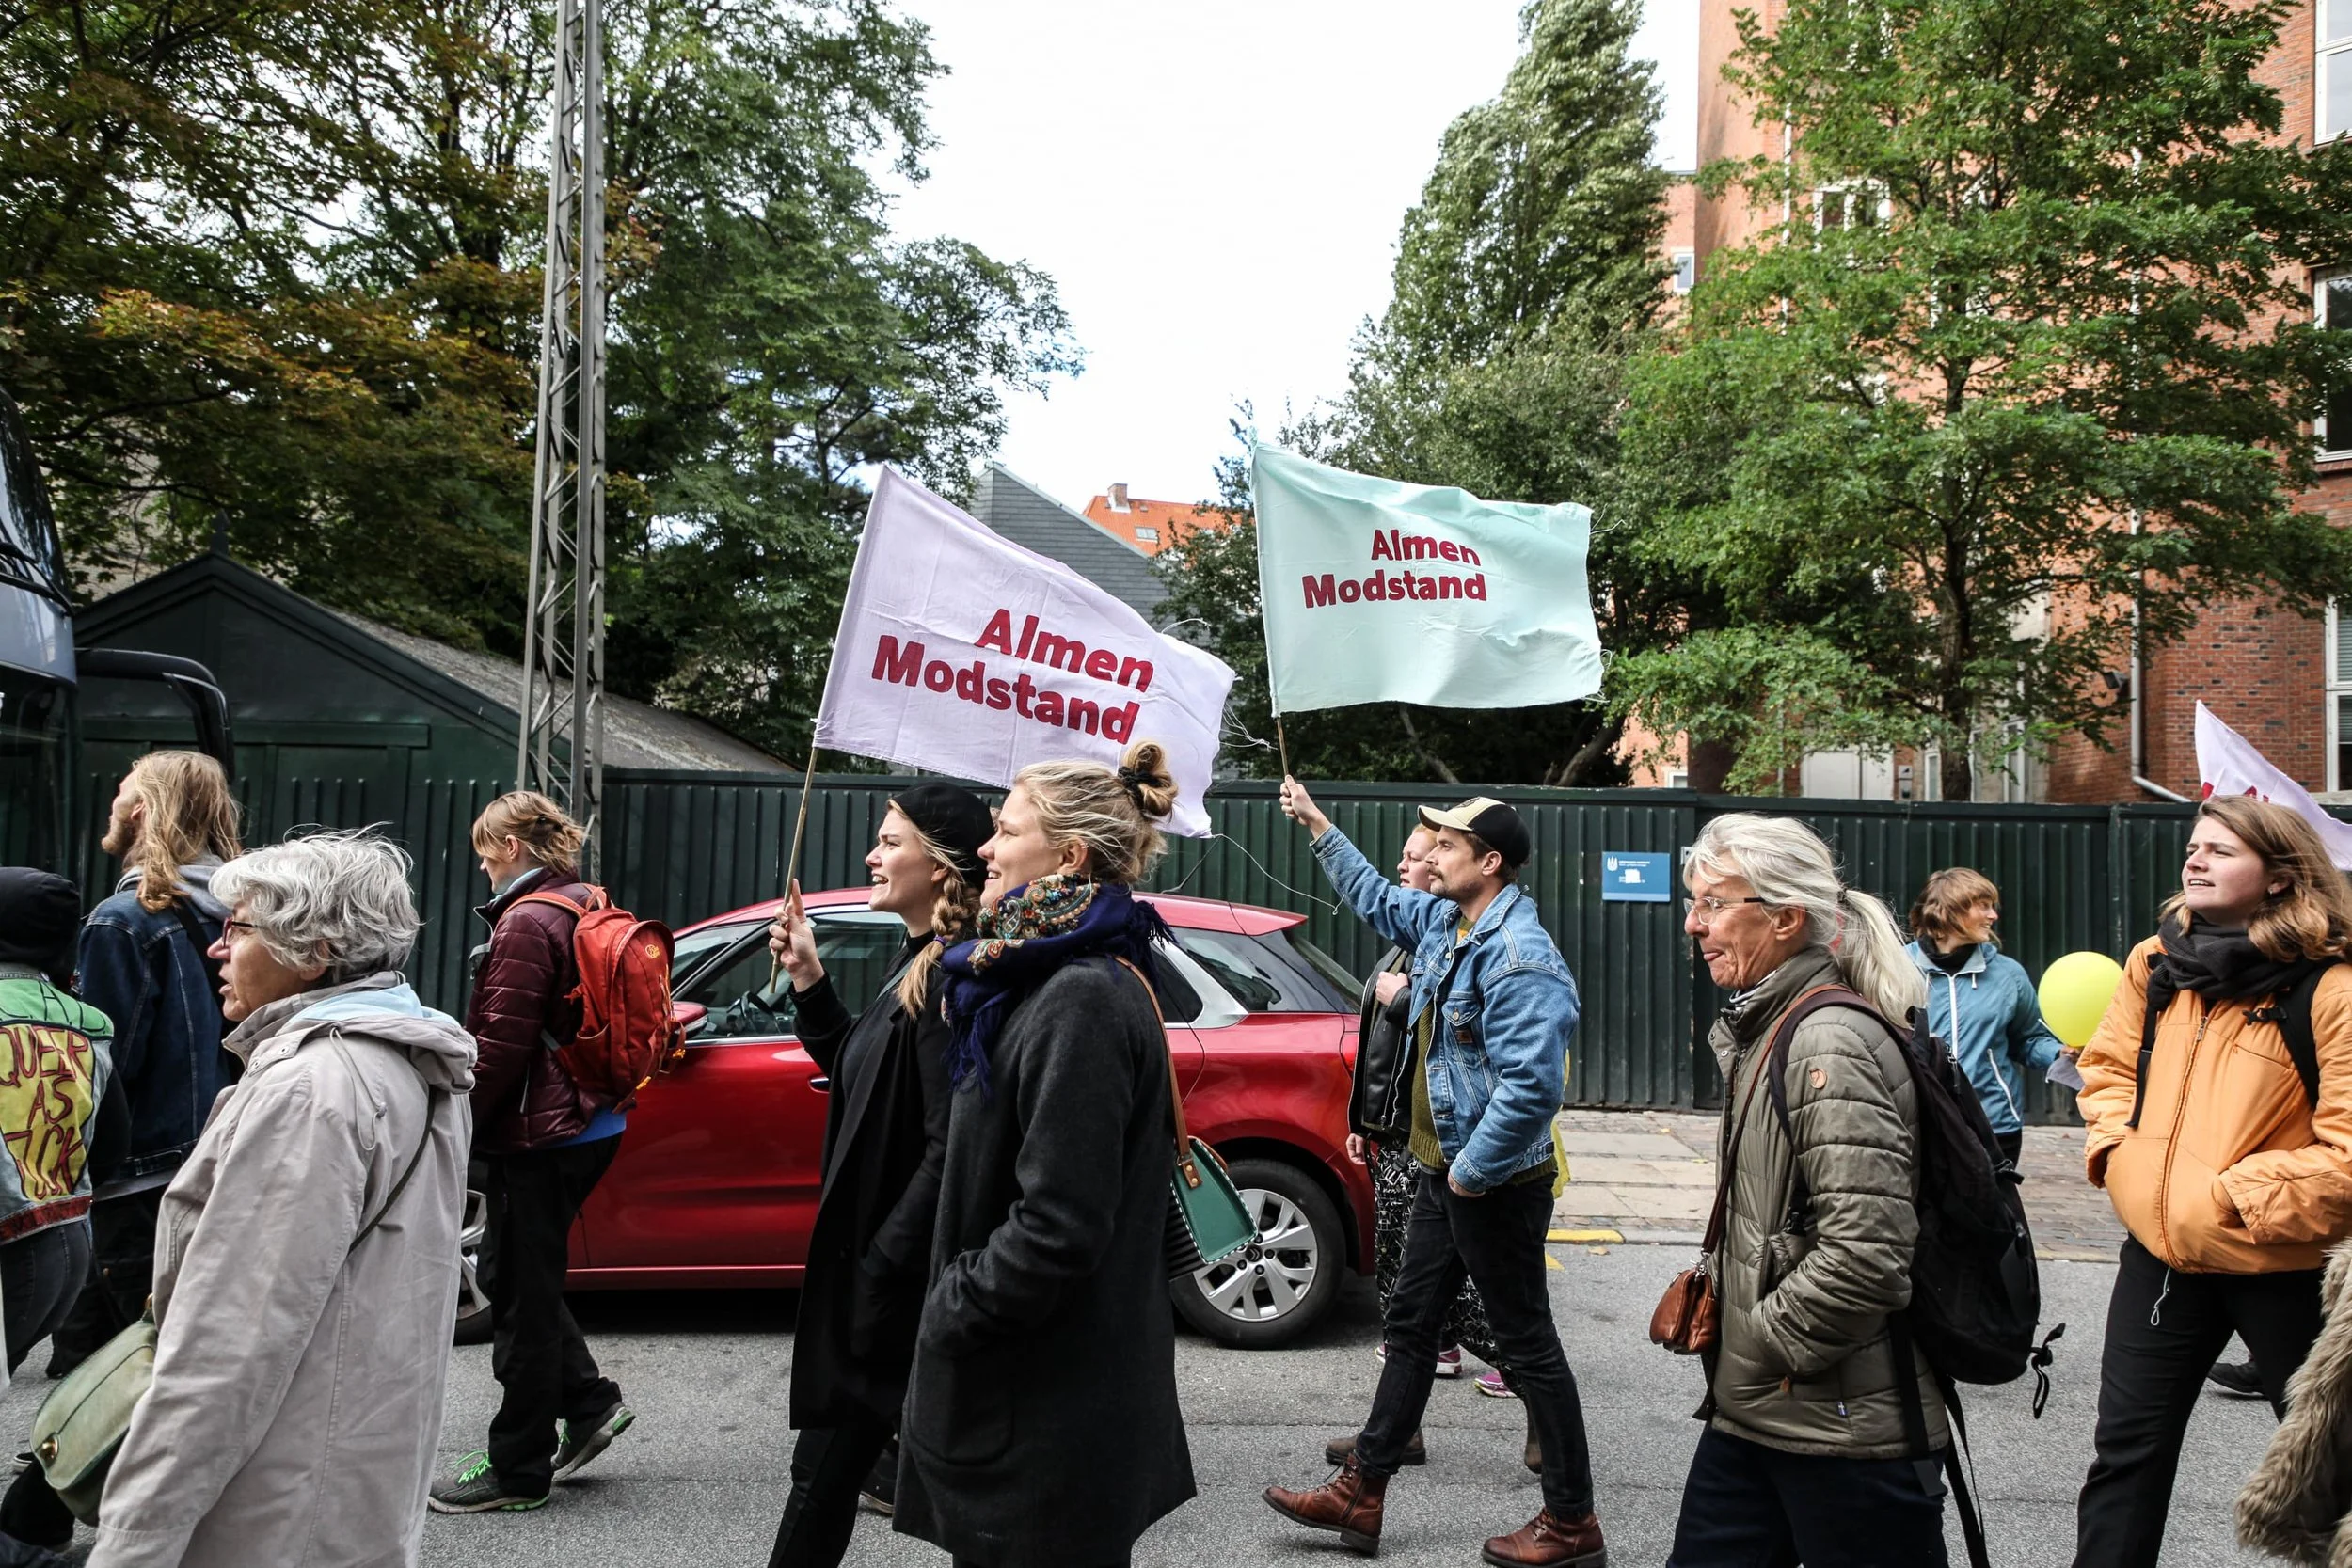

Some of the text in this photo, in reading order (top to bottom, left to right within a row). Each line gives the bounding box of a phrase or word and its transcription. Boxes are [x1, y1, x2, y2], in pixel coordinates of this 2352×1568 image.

[1371, 529, 1481, 566] Almen
[1302, 569, 1487, 609] Modstand
[974, 608, 1154, 693] Almen
[871, 635, 1141, 745] Modstand
[27, 1075, 76, 1130] AS
